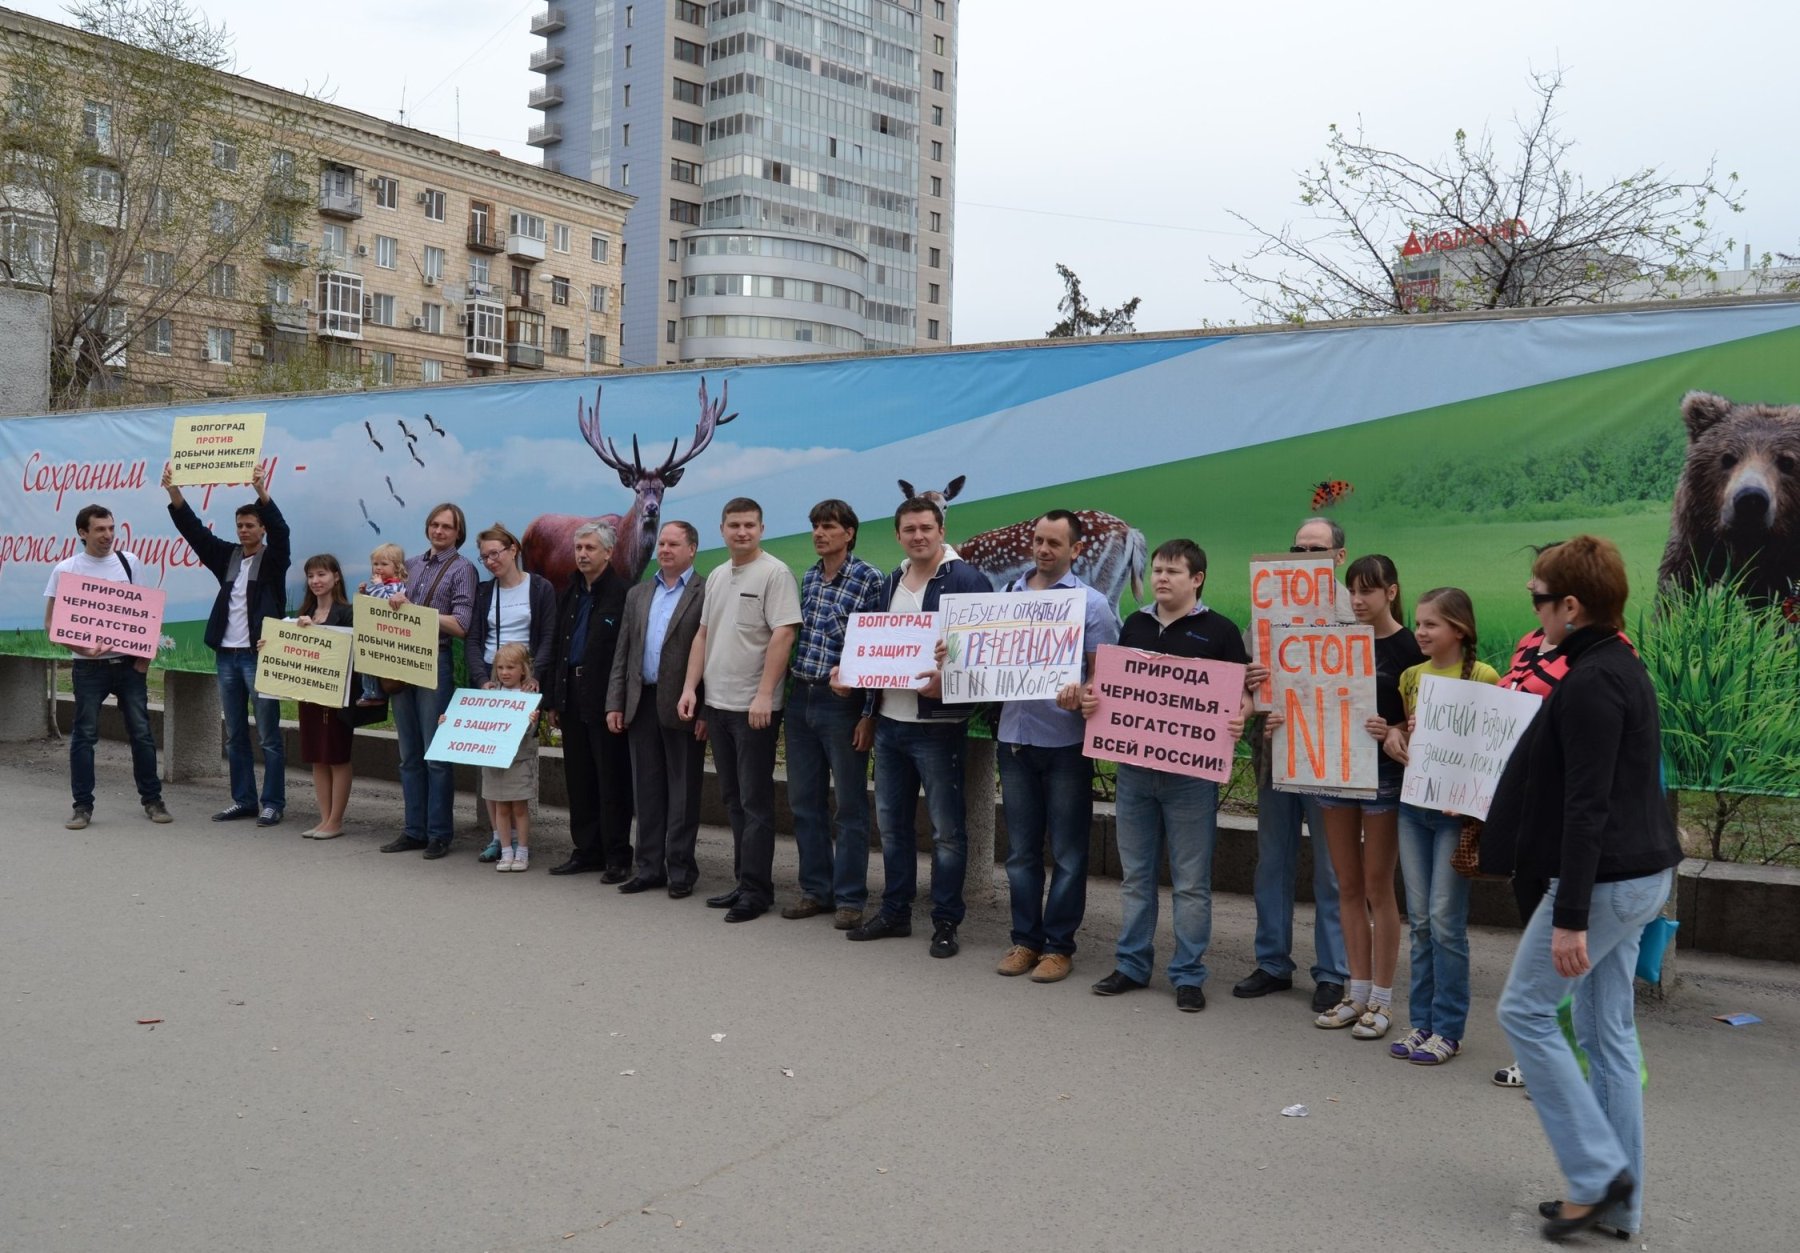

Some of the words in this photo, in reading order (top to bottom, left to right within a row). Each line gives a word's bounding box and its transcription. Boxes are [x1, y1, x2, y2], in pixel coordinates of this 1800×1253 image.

[191, 423, 245, 432] ВОЛГОГРАД
[196, 436, 233, 444] ПРОТИВ
[174, 450, 215, 459] ДОБЫЧИ
[218, 448, 255, 456] НИКЕЛЯ
[184, 461, 254, 470] ЧЕРНОЗЕМЬЕ!!!
[23, 452, 146, 512] Сохраним
[82, 582, 142, 602] ПРИРОДА
[1252, 568, 1334, 609] СТОП
[62, 596, 149, 618] ЧЕРНОЗЕМЬЯ
[370, 608, 421, 626] ВОЛГОГРАД
[70, 614, 146, 634] БОГАТСТВО
[376, 624, 412, 637] ПРОТИВ
[858, 615, 932, 628] ВОЛГОГРАД
[56, 628, 92, 642] ВСЕЙ
[96, 635, 152, 652] РОССИИ!
[279, 630, 332, 648] ВОЛГОГРАД
[358, 634, 395, 648] ДОБЫЧИ
[398, 642, 432, 656] НИКЕЛЯ
[965, 626, 1080, 670] РЕФЕРЕНДУМ
[284, 646, 320, 660] ПРОТИВ
[360, 648, 366, 656] В
[368, 650, 432, 671] ЧЕРНОЗЕМЬЕ!!!
[858, 646, 866, 657] В
[869, 646, 922, 658] ЗАЩИТУ
[1279, 634, 1374, 676] СТОП
[262, 656, 302, 670] ДОБЫЧИ
[304, 664, 340, 678] НИКЕЛЯ
[1125, 660, 1209, 686] ПРИРОДА
[272, 672, 338, 692] ЧЕРНОЗЕМЬЕ!!!
[856, 676, 910, 688] ХОПРА!!!
[944, 670, 962, 697] НЕТ
[460, 696, 526, 711] ВОЛГОГРАД
[1101, 683, 1218, 714] ЧЕРНОЗЕМЬЯ
[454, 719, 462, 728] В
[464, 720, 512, 732] ЗАЩИТУ
[1111, 712, 1216, 742] БОГАТСТВО
[1285, 687, 1350, 782] Ni
[448, 742, 496, 754] ХОПРА!!!
[1093, 736, 1138, 756] ВСЕЙ
[1144, 746, 1223, 772] РОССИИ!
